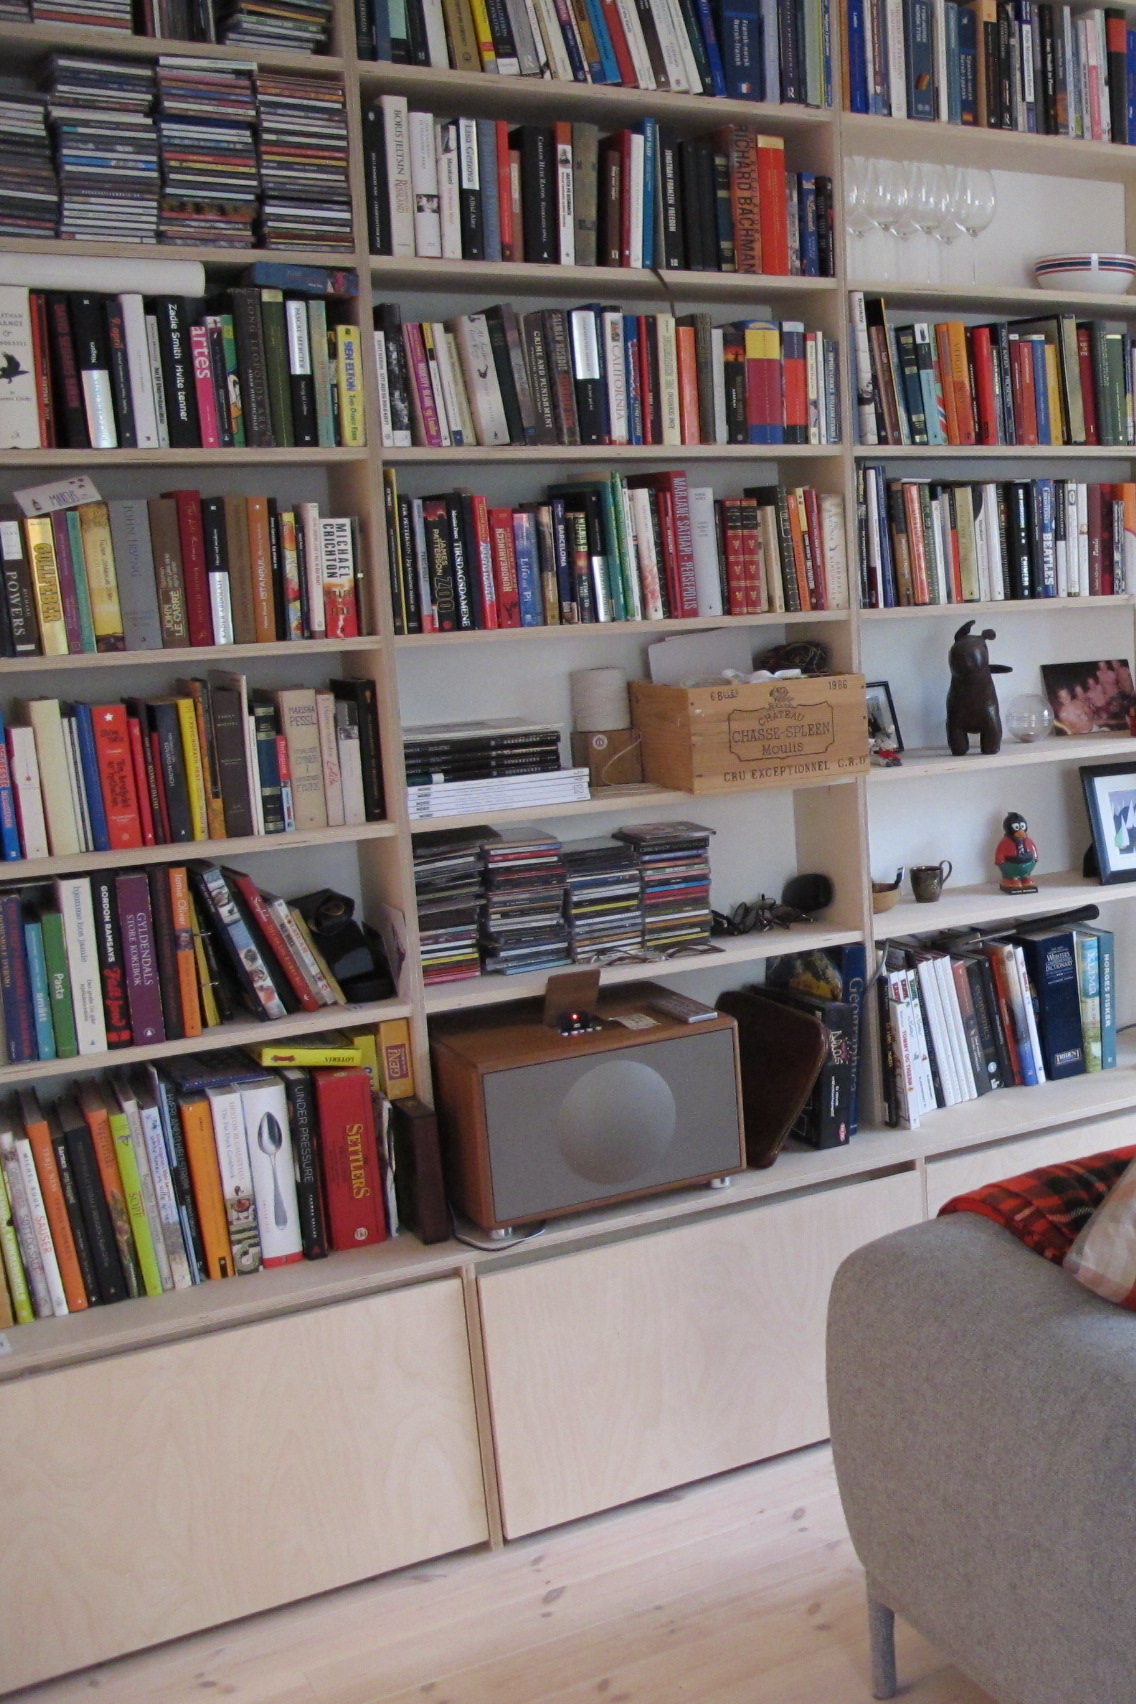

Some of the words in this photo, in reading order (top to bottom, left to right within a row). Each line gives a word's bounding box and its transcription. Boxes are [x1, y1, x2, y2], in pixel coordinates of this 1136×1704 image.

[394, 110, 403, 137] BORIS
[395, 140, 405, 175] JELTSIN
[466, 147, 474, 182] Genova
[735, 126, 752, 191] RICHARD
[739, 196, 757, 274] BACHMAN
[169, 304, 179, 329] Zadie
[172, 332, 182, 358] Smith
[191, 326, 211, 379] artes
[175, 365, 185, 388] Hvite
[534, 331, 542, 358] CRIME
[541, 378, 552, 428] PUNISHMENT
[612, 345, 624, 419] CALIFORNIA
[178, 391, 188, 421] tenner
[673, 477, 688, 518] MARJANE
[323, 524, 338, 578] CRICHTON
[335, 524, 351, 578] MICHAEL
[432, 529, 442, 576] PATTERSON
[440, 539, 448, 565] JAMES
[558, 525, 566, 566] BARCELONA
[677, 521, 693, 555] SATRAPI
[521, 558, 530, 579] Life
[1043, 533, 1053, 585] BEATLES
[434, 577, 454, 612] ZOO
[454, 542, 470, 626] TIRSDAGSDAMENE
[523, 591, 531, 601] Pi
[680, 562, 697, 609] PERSEPOLIS
[5, 571, 25, 636] POWERS
[829, 680, 848, 690] 1986
[289, 715, 316, 726] PESSL
[733, 722, 830, 743] CHASSE-SPLEEN
[758, 710, 806, 726] CHATEAU
[724, 771, 746, 783] CRU
[752, 761, 830, 779] EXCEPTIONNEL
[101, 886, 110, 921] GORDON
[174, 873, 185, 899] Jamie
[104, 924, 115, 962] RAMSAYS
[126, 914, 137, 942] STORE
[130, 945, 141, 986] KOKEBOK
[136, 912, 153, 985] GYLDENDALS
[54, 973, 65, 999] Pasta
[295, 1086, 307, 1124] UNDER
[300, 1128, 313, 1183] PRESSURE
[345, 1124, 370, 1198] SETTLERS
[23, 1152, 33, 1182] MICHEL
[31, 1186, 40, 1208] ROUX
[36, 1215, 51, 1253] SAUSER
